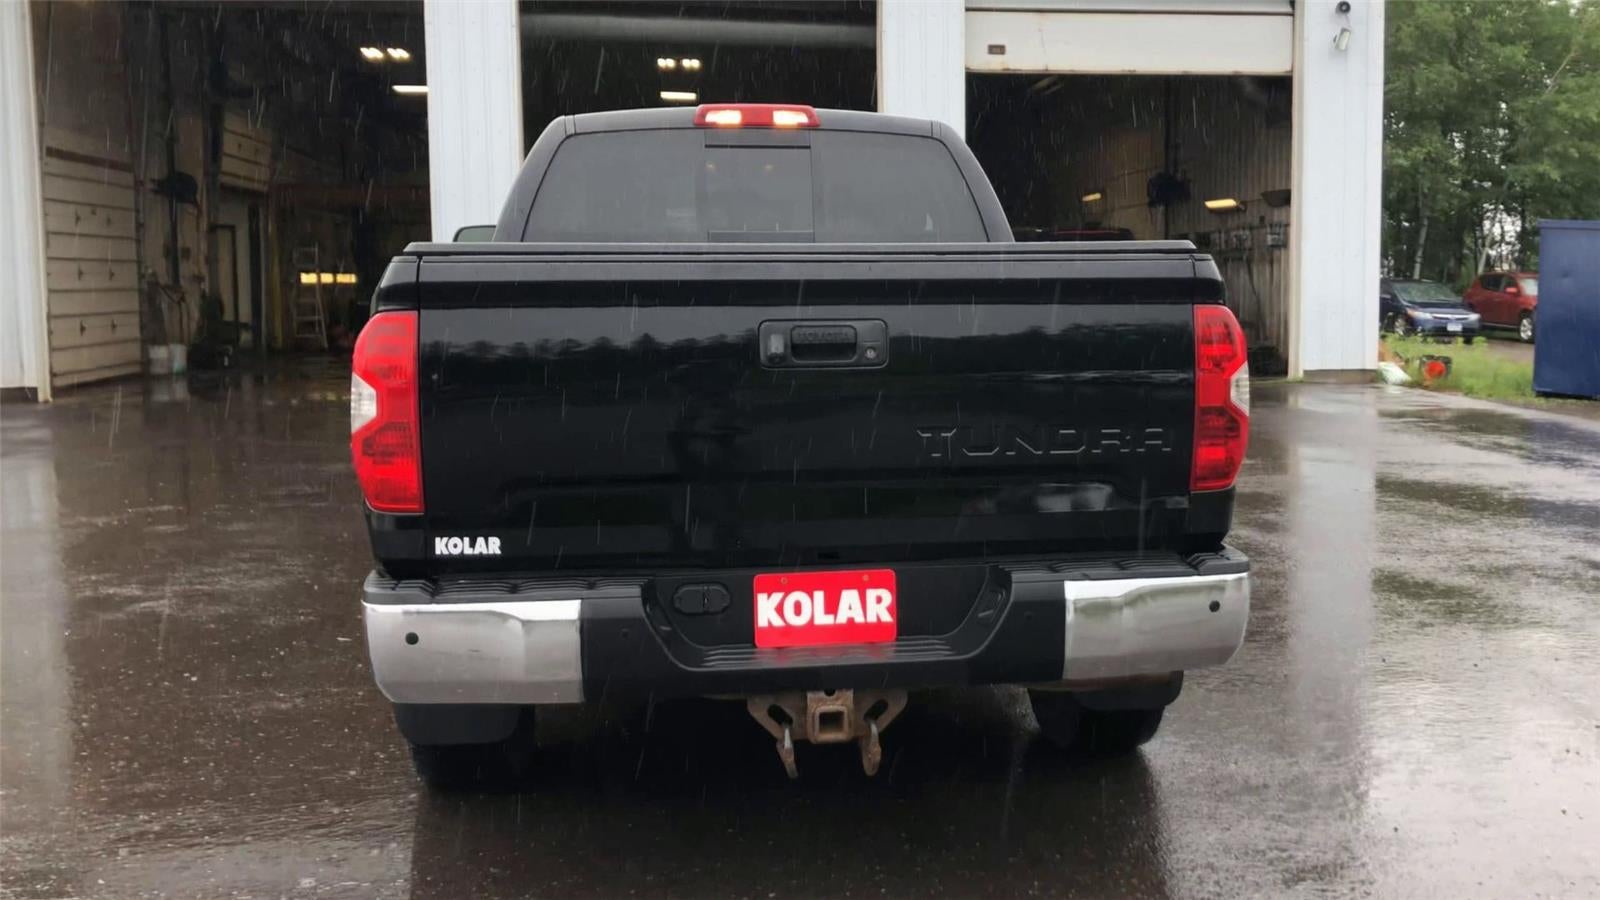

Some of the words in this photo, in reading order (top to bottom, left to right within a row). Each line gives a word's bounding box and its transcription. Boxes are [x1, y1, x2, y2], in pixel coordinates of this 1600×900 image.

[916, 427, 1173, 457] TUNDRA
[434, 536, 502, 555] KOLAR
[757, 588, 893, 628] KOLAR
